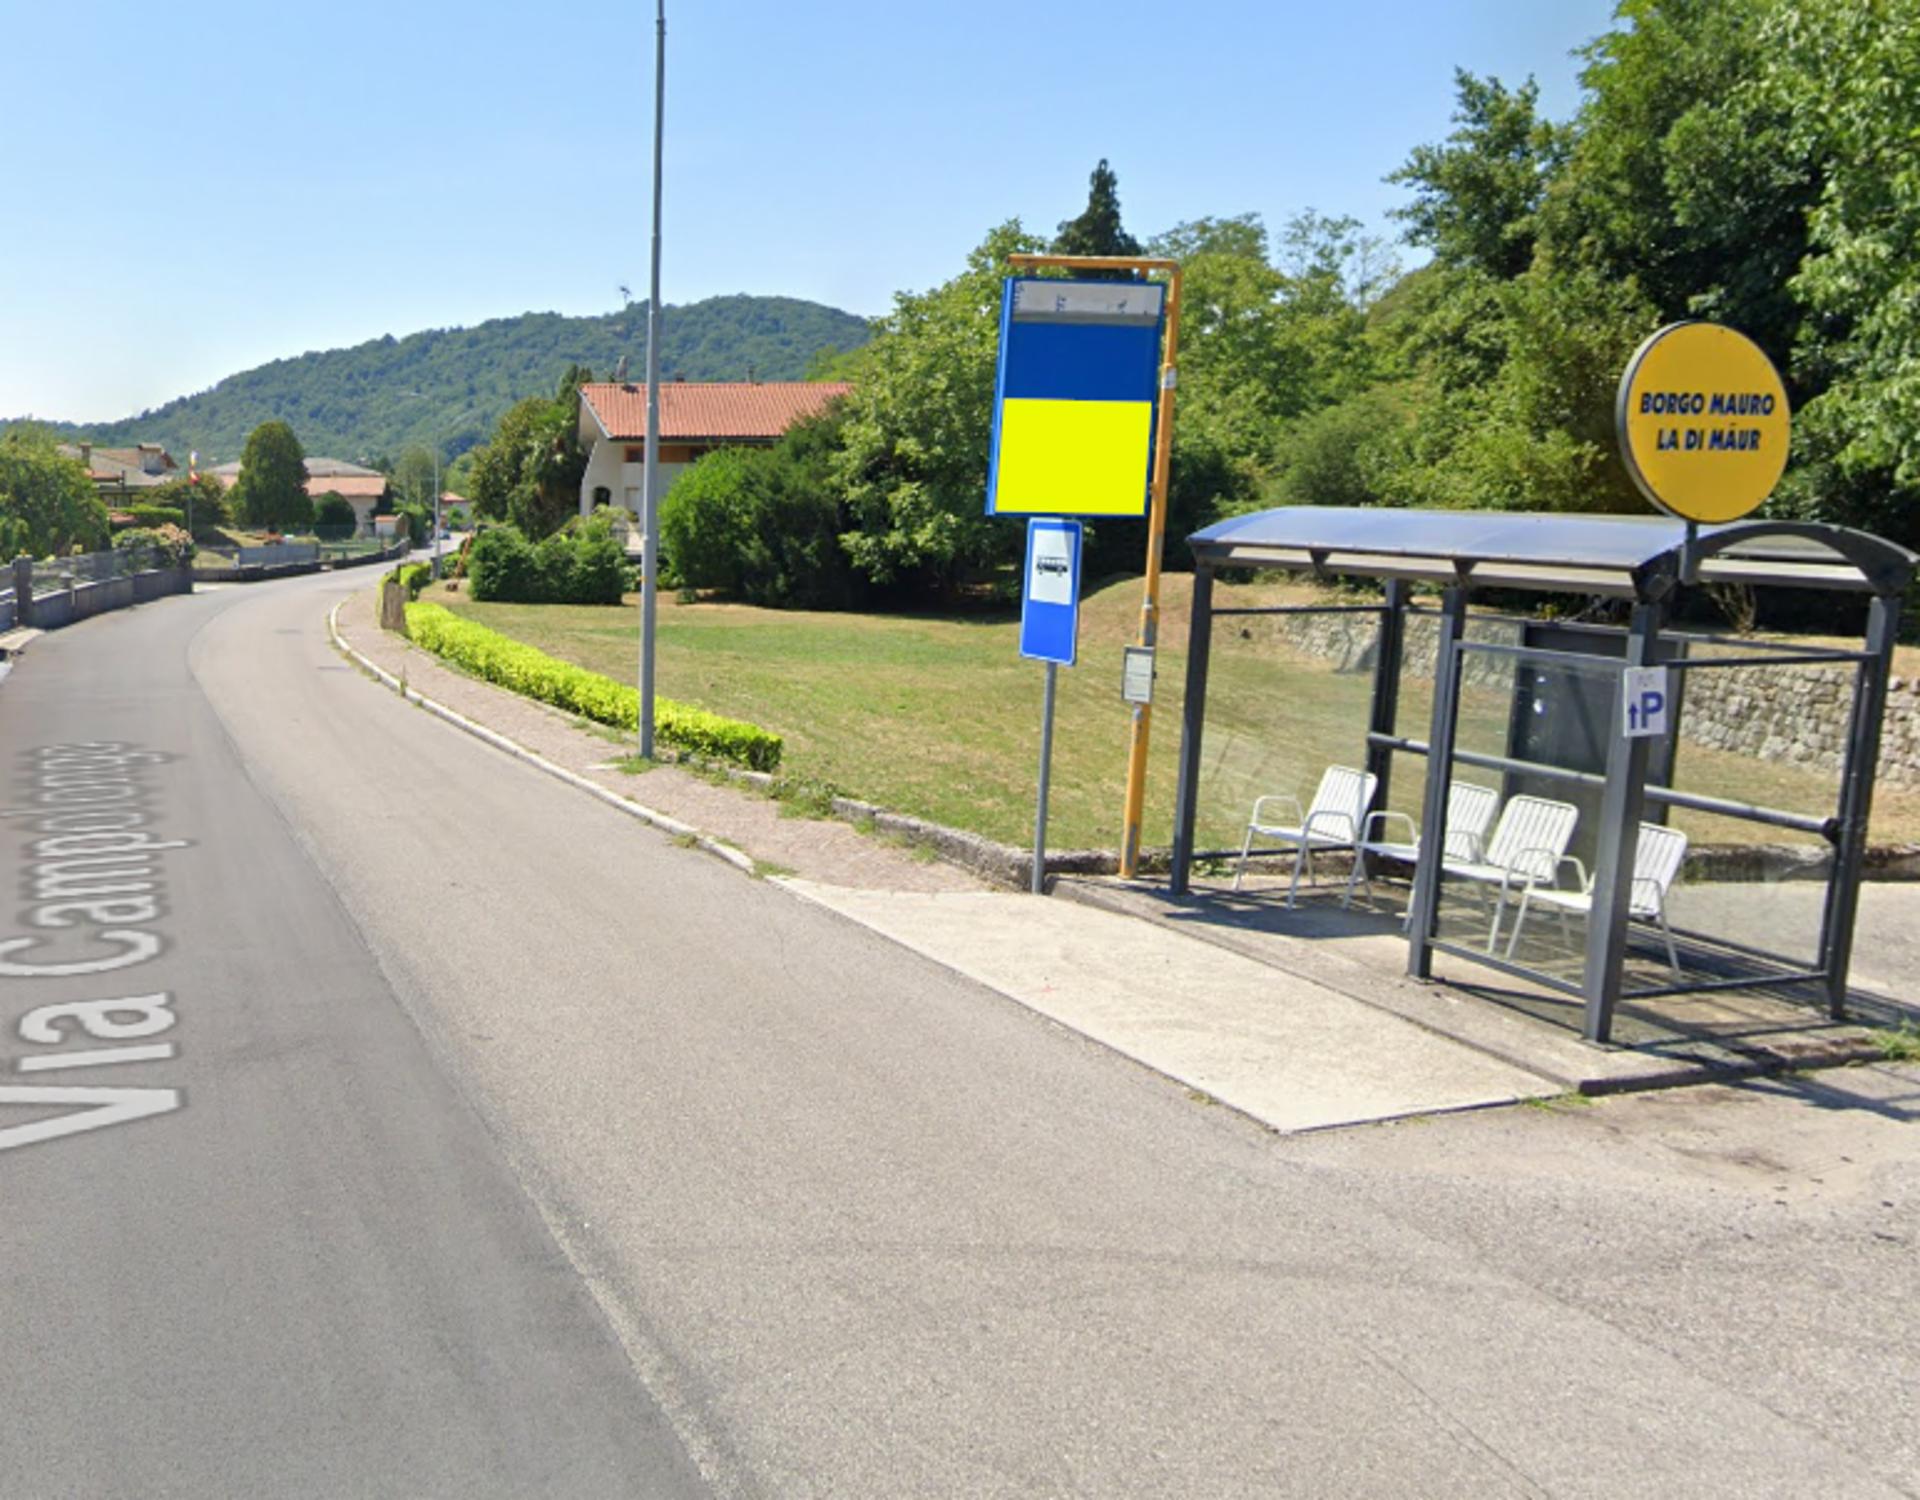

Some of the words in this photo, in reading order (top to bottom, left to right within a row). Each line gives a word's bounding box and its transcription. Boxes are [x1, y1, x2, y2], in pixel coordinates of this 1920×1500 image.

[1640, 392, 1704, 414] BORGO
[1709, 393, 1775, 415] MAURO
[1656, 428, 1679, 450] LA
[1685, 428, 1704, 450] DI
[1641, 691, 1663, 729] P
